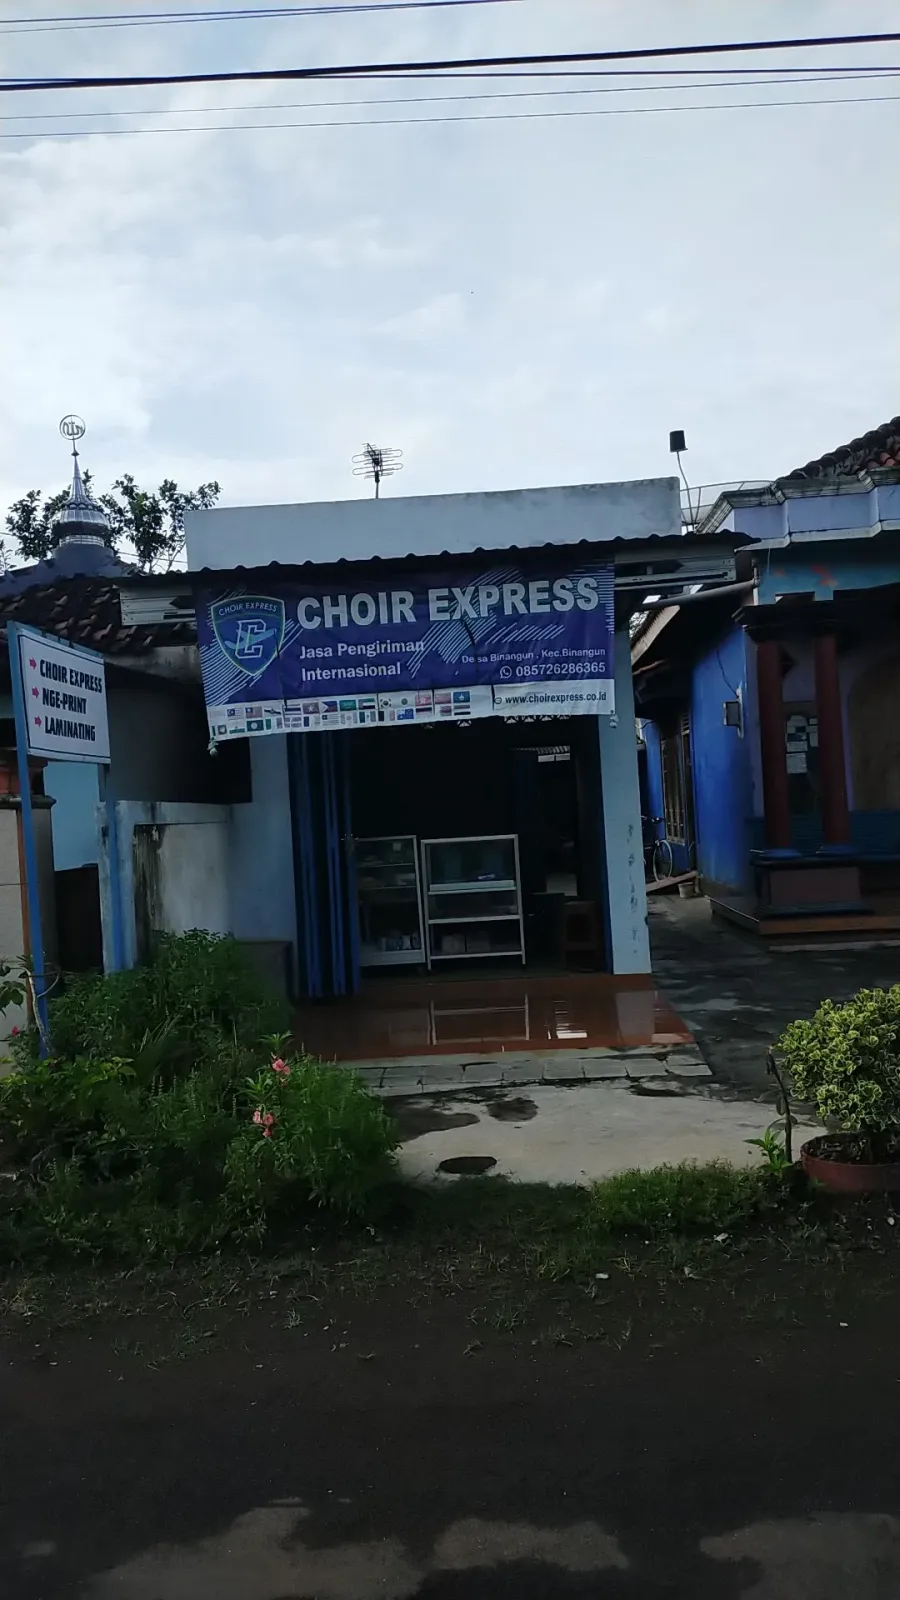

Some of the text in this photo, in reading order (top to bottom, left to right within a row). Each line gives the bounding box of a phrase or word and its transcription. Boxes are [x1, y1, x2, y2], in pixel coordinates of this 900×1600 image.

[218, 602, 277, 616] CHOIR EXPRESS
[297, 577, 599, 630] CHOIR EXPRESS
[300, 639, 425, 659] Jasa Pengiriman
[490, 651, 534, 661] Binangun
[40, 659, 102, 693] CHOIR EXPRESS
[302, 661, 401, 682] Internasional
[515, 662, 606, 677] 085726286365
[42, 687, 87, 714] NGE-PRINT
[44, 715, 96, 742] LAMINATING
